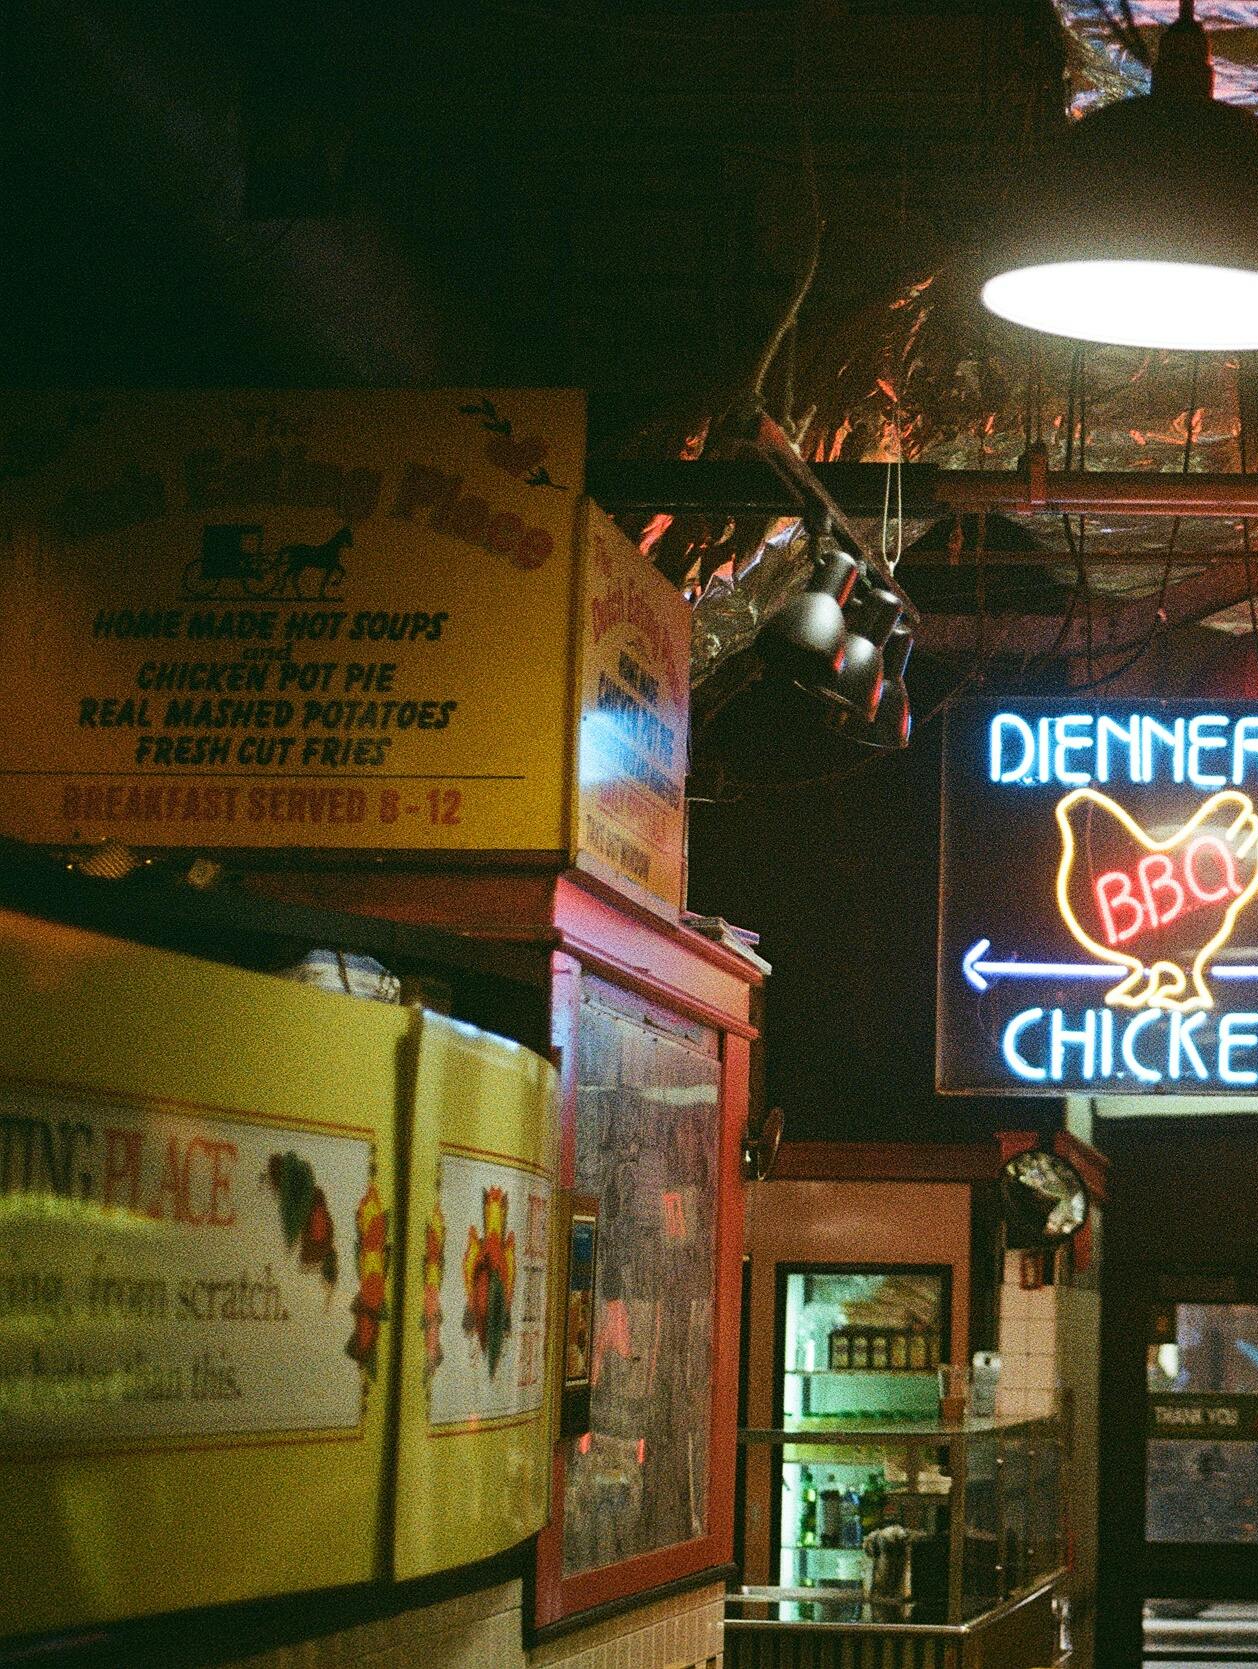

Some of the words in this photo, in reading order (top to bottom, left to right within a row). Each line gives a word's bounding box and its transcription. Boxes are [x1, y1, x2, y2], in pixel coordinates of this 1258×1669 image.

[389, 462, 554, 570] Place
[92, 610, 182, 638] HOME
[187, 610, 278, 639] MADE
[284, 611, 346, 640] HOT
[349, 611, 448, 641] SOUPS
[243, 644, 292, 661] and
[136, 661, 270, 691] CHICKEN
[277, 662, 338, 692] POT
[344, 663, 397, 692] PIE
[79, 696, 152, 728] REAL
[163, 698, 294, 728] MASHED
[301, 701, 457, 729] POTATOES
[135, 735, 232, 765] FRESH
[236, 736, 296, 765] CUT
[302, 737, 392, 766] FRIES
[62, 785, 241, 822] BREAKFAST
[247, 786, 366, 822] SERVED
[1095, 835, 1243, 944] BBQ
[103, 1127, 238, 1226] PLACE
[1154, 1406, 1202, 1425] THANK
[1207, 1408, 1239, 1425] YOU
